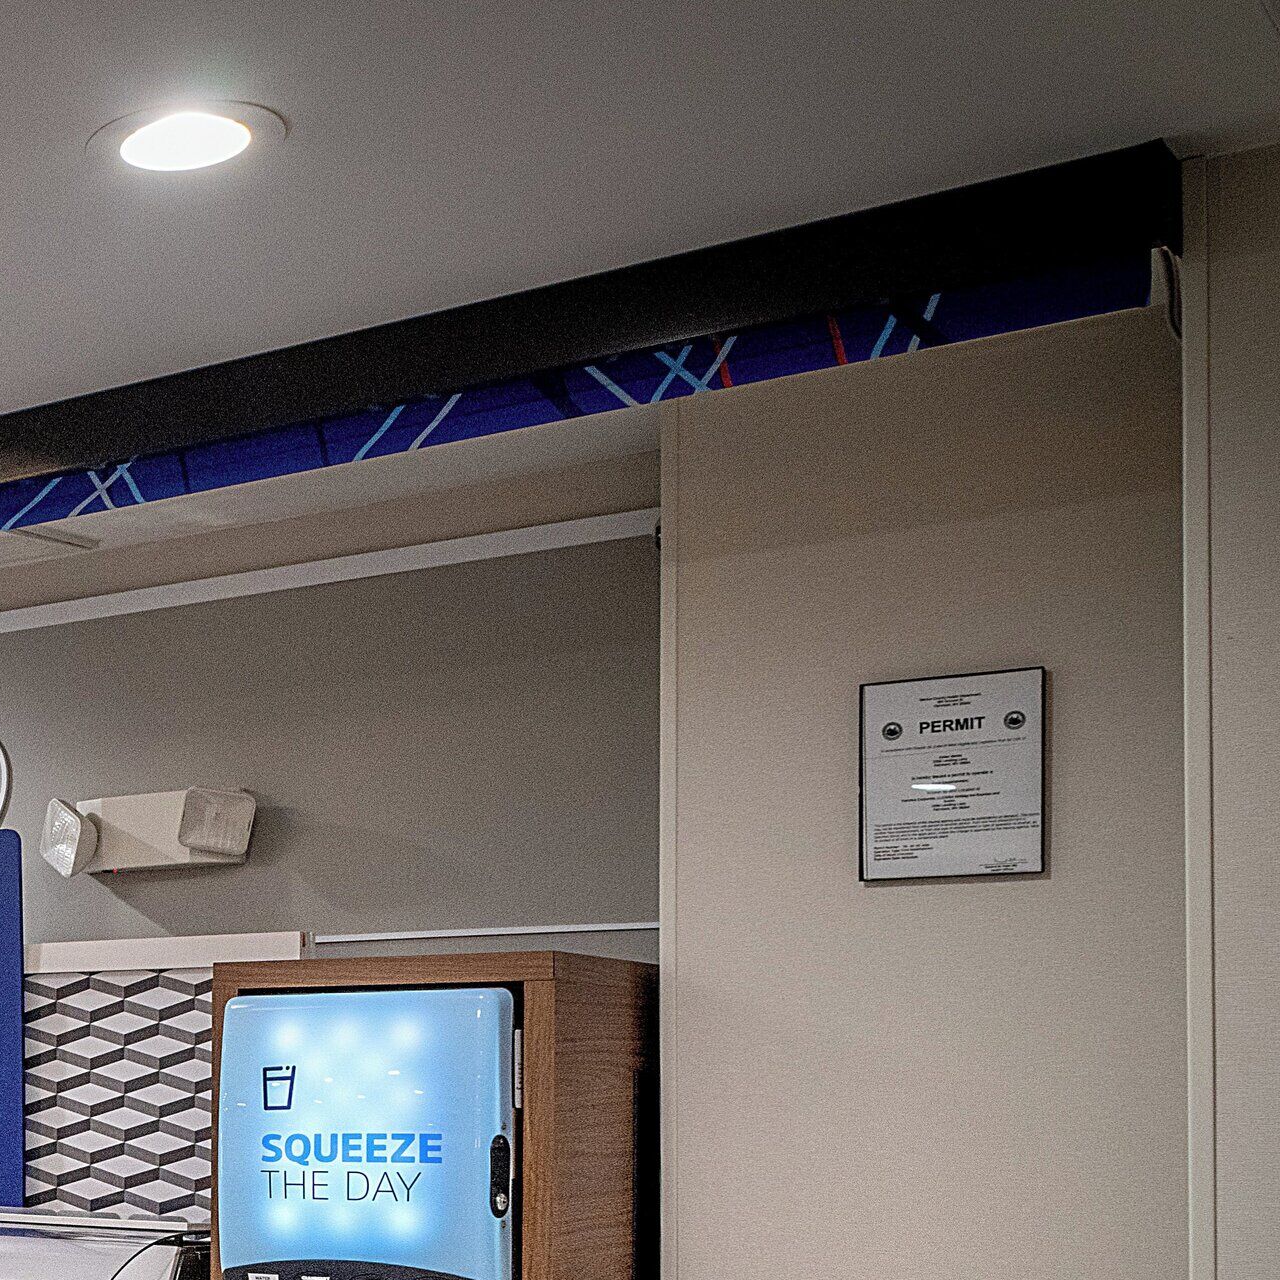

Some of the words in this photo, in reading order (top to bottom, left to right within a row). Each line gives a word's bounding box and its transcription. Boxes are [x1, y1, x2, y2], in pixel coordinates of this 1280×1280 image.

[919, 716, 986, 735] PERMIT
[261, 1132, 443, 1167] SQUEEZE
[260, 1169, 329, 1201] THE
[346, 1171, 422, 1202] DAY
